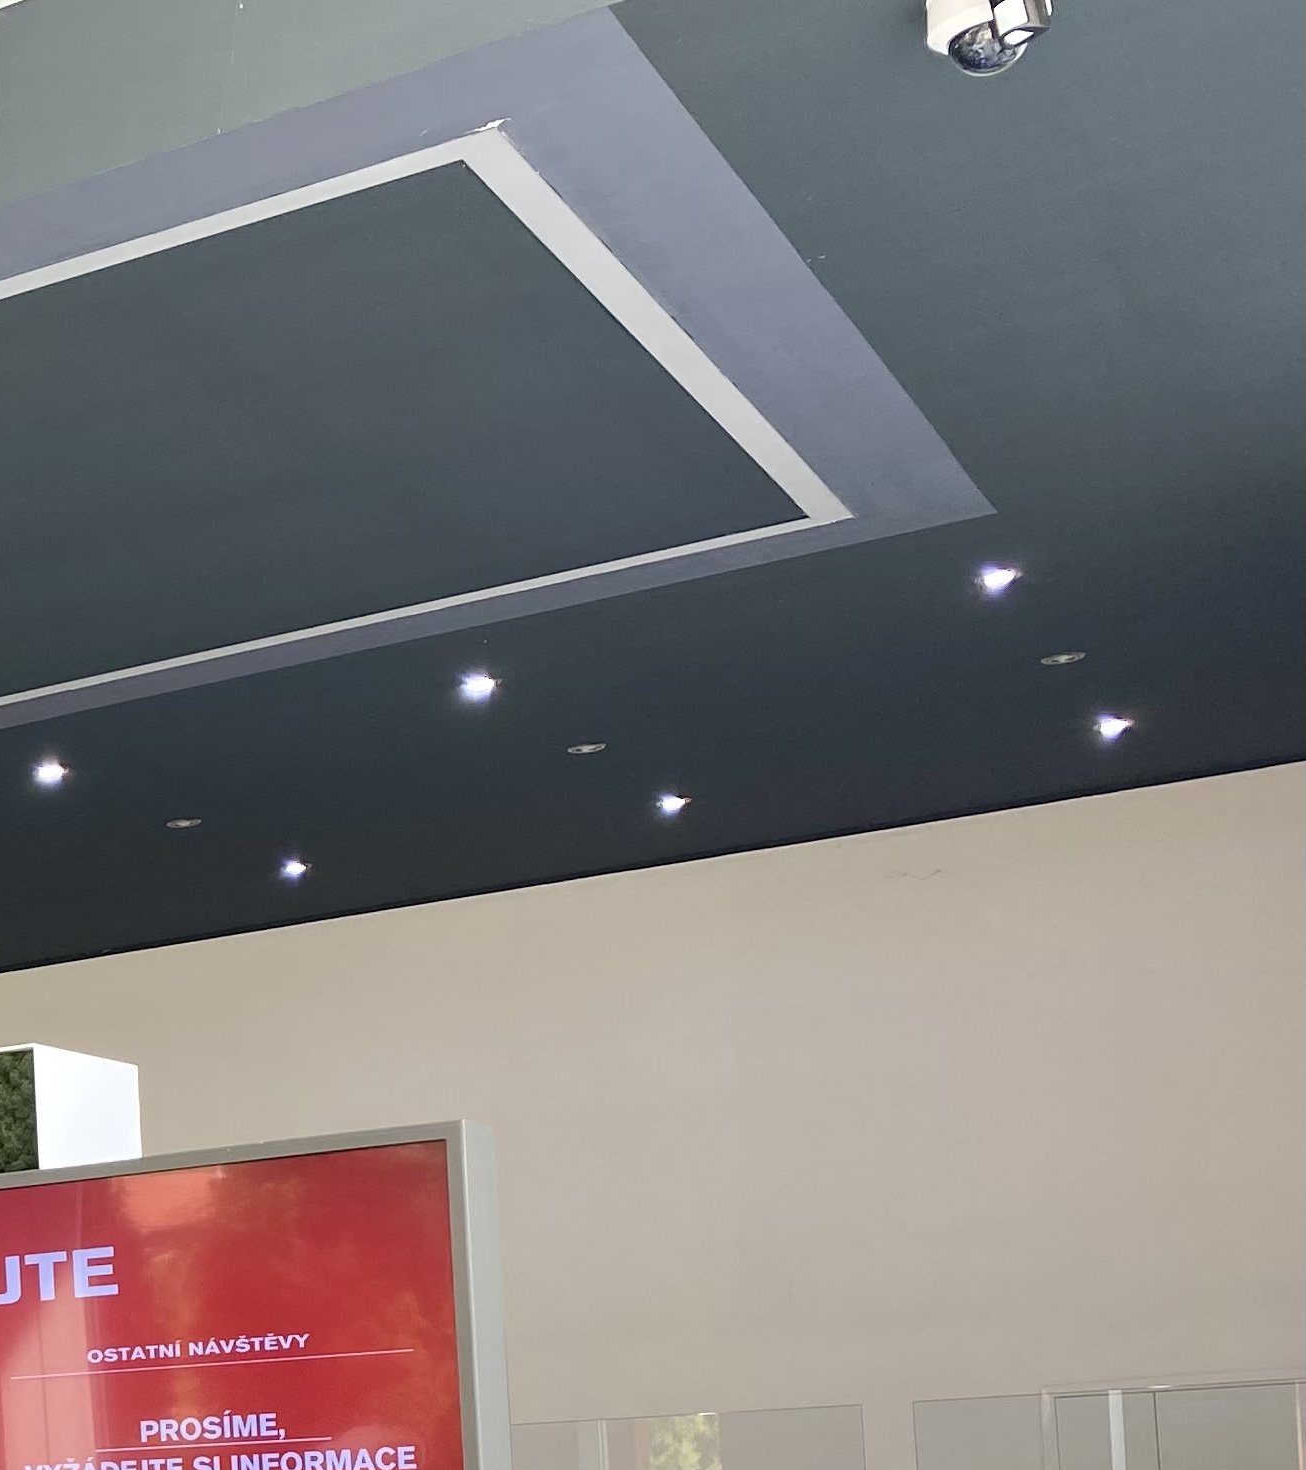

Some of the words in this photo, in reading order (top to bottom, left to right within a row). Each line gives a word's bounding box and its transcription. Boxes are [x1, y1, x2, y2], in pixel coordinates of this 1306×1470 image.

[87, 1339, 181, 1364] OSTATNÍ
[188, 1333, 310, 1356] NÁVŠTĚVY
[139, 1410, 286, 1443] PROSÍME,
